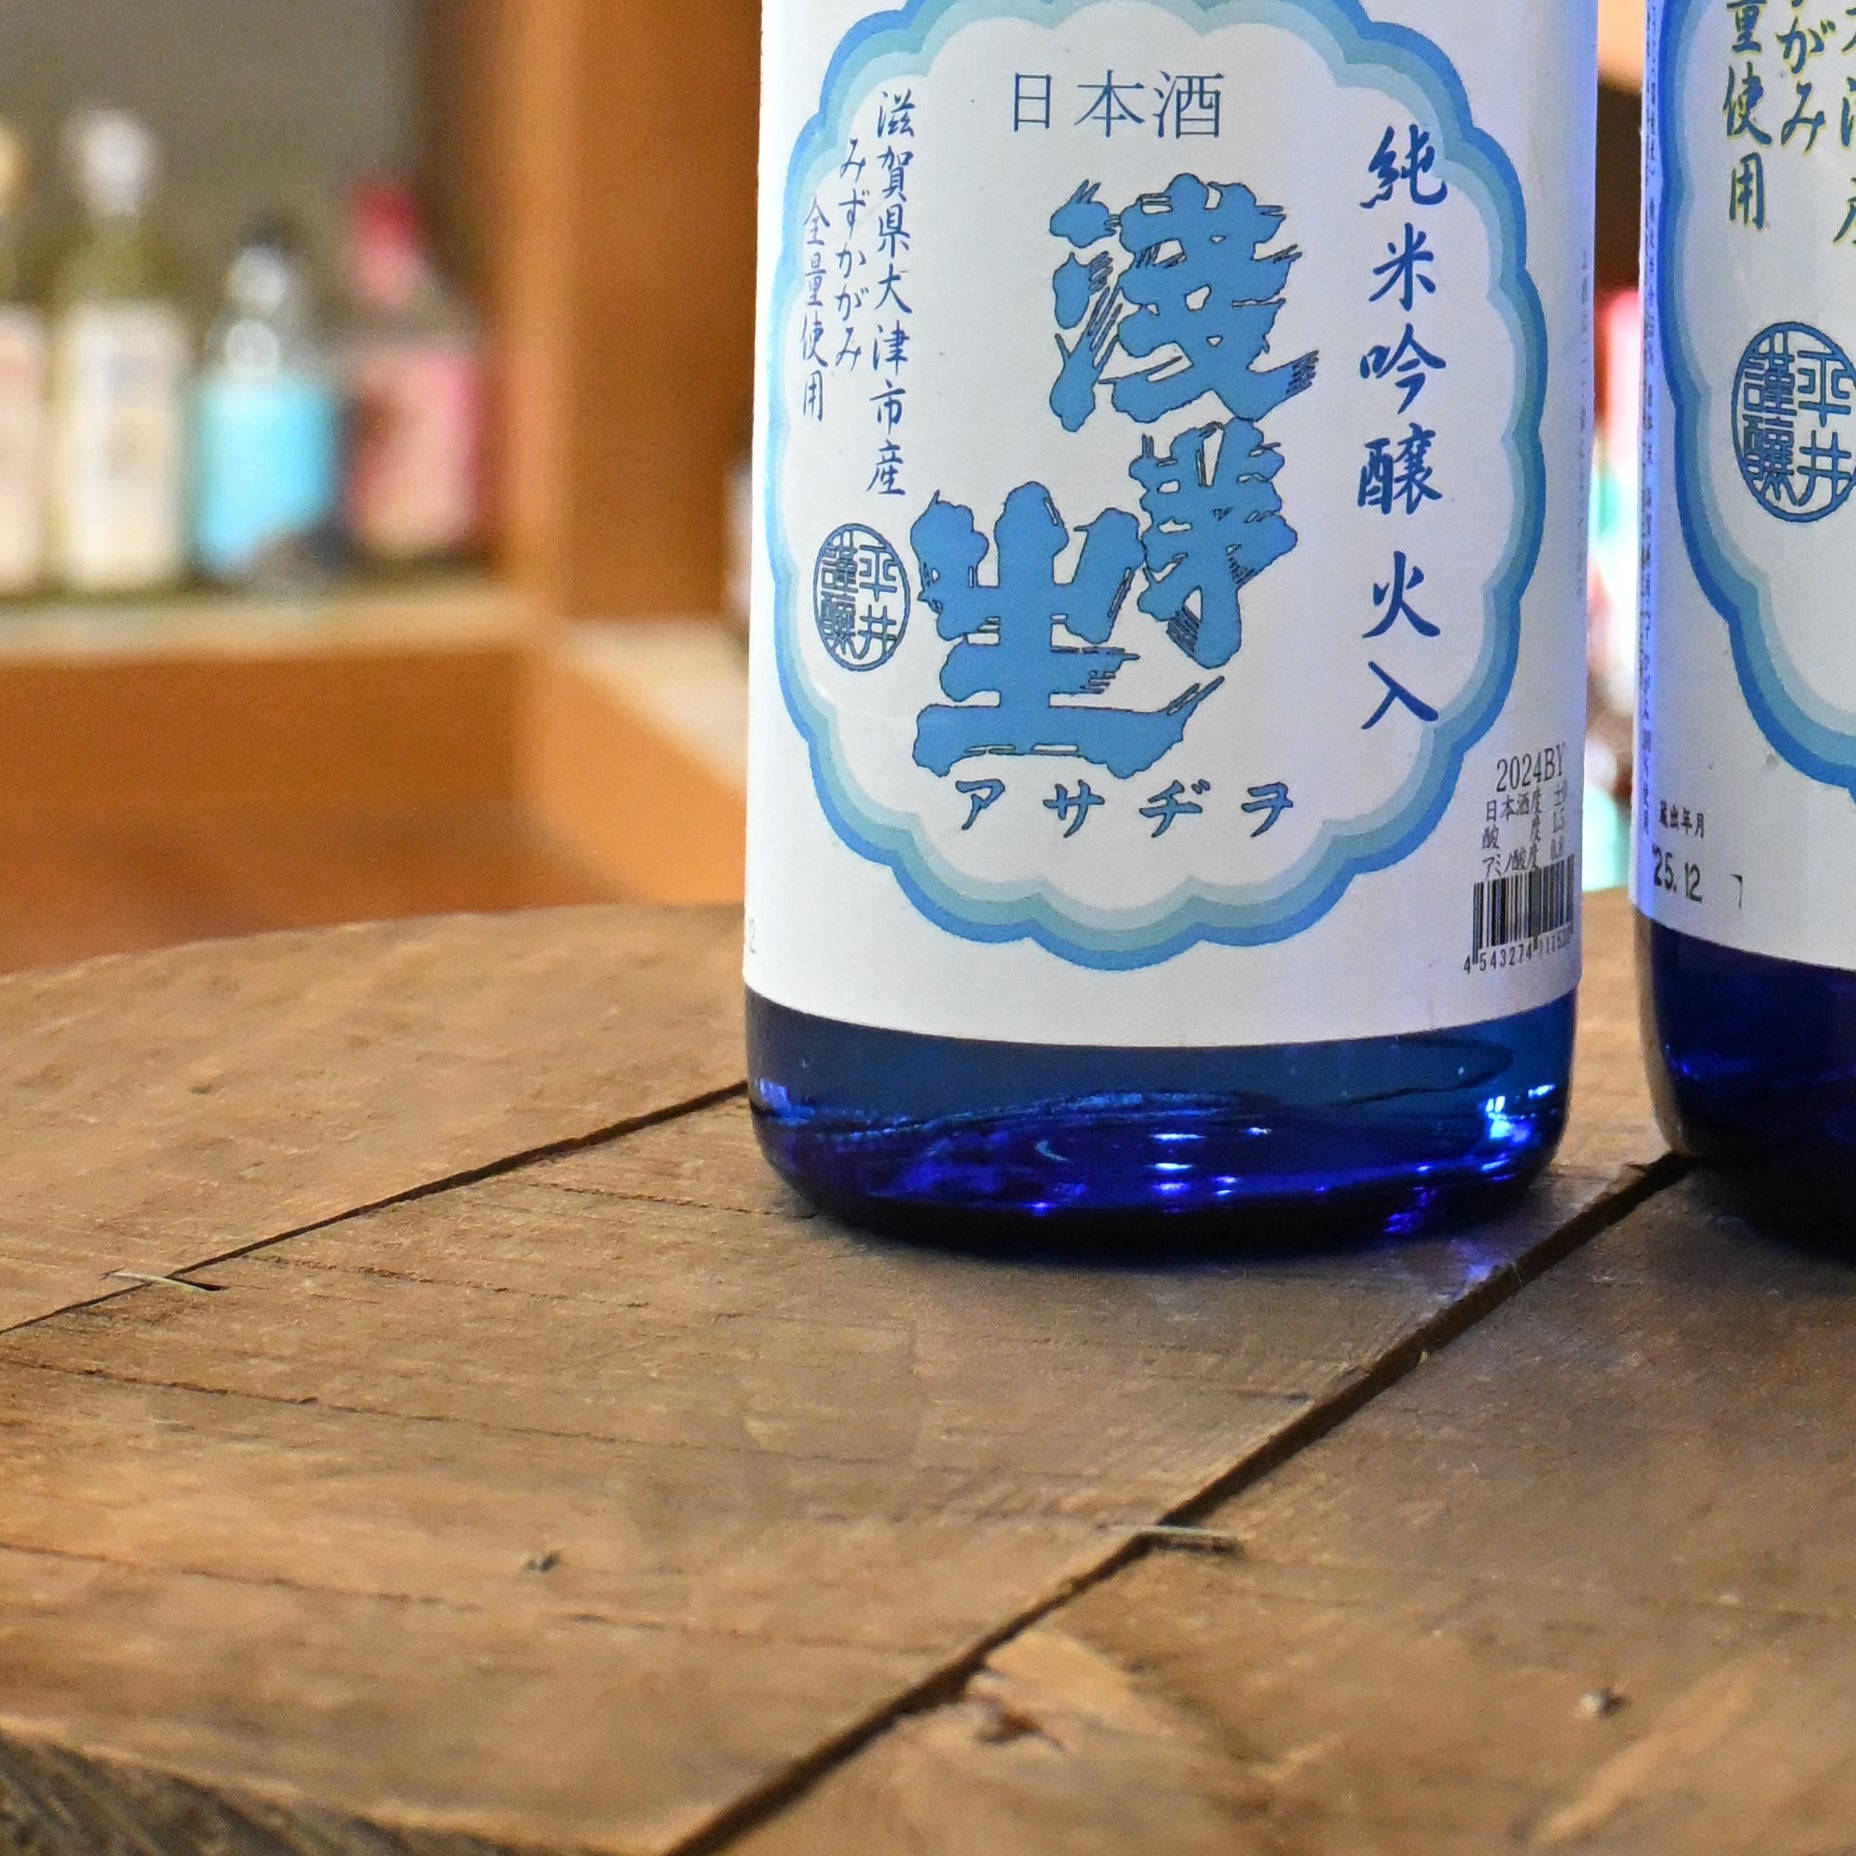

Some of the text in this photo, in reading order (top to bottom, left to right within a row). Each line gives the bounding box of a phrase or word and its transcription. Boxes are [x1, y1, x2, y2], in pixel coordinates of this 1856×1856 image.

[1013, 69, 1225, 140] 日本酒
[800, 197, 831, 422] 全量使用
[833, 137, 870, 372] みずかがみ
[866, 90, 915, 496] 滋賀県大津市産
[1486, 786, 1542, 822] 日本酒度
[1496, 742, 1567, 793] 2024BY
